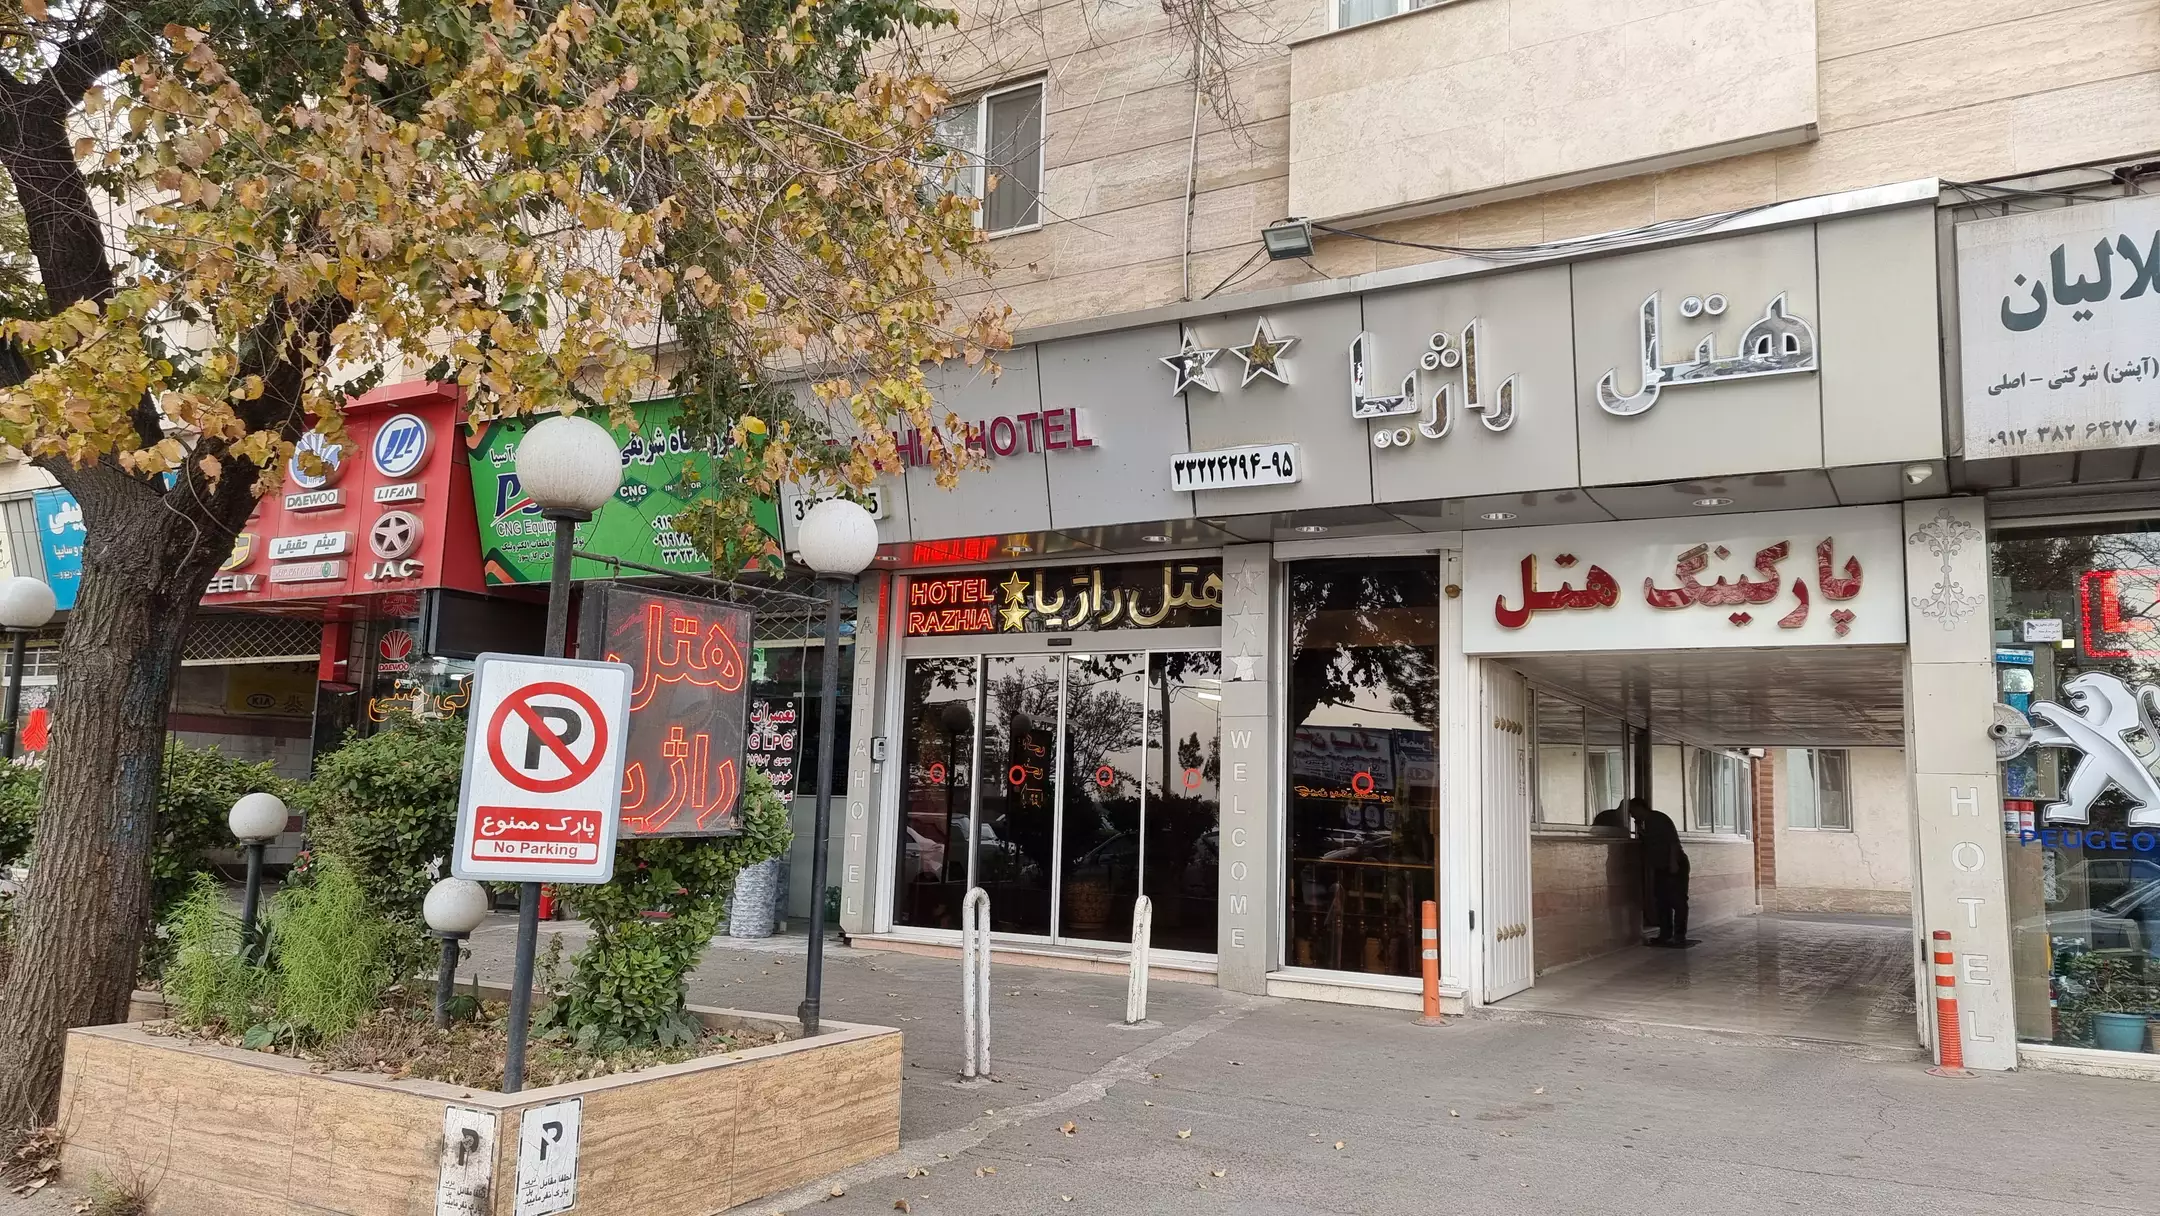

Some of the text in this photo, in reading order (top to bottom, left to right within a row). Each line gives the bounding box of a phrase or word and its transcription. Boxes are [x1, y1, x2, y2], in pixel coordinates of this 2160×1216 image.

[2001, 229, 2160, 331] لالیان
[1348, 290, 1819, 449] هتل راژیا
[2048, 364, 2099, 389] شرکتی
[2103, 356, 2160, 384] (آپشن)
[1988, 371, 2026, 396] اصلی
[964, 407, 1093, 461] HOTEL
[1988, 429, 2028, 446] ۰۹۱۲
[2037, 424, 2076, 443] ۳۸۲
[2085, 418, 2138, 440] ۶۴۲۷
[1174, 451, 1293, 485] ۳۳۲۲۴۲۹۴-۹۵
[287, 492, 336, 508] DAEWOO
[377, 486, 415, 500] LIFAN
[620, 485, 648, 498] CNG
[497, 521, 522, 537] CNG
[277, 535, 337, 555] میثم حقیقی
[364, 558, 424, 581] JAC
[205, 573, 258, 594] EELY
[911, 578, 995, 605] HOTEL
[1034, 563, 1223, 628] هتل راژیا
[1494, 536, 1864, 637] پارکینگ هتل
[908, 607, 994, 634] RAZHIA
[378, 662, 410, 673] DAEWOO
[607, 604, 744, 712] هتل
[750, 701, 796, 728] تعمیرات
[763, 733, 794, 751] LPG
[620, 726, 738, 833] راژی
[480, 816, 596, 839] پارک ممنوع
[1229, 729, 1252, 950] WELCOME
[2020, 829, 2160, 852] PEUGEO
[494, 841, 578, 859] No Parking
[845, 769, 866, 916] HOTEL
[1950, 786, 1995, 1043] HOTEL
